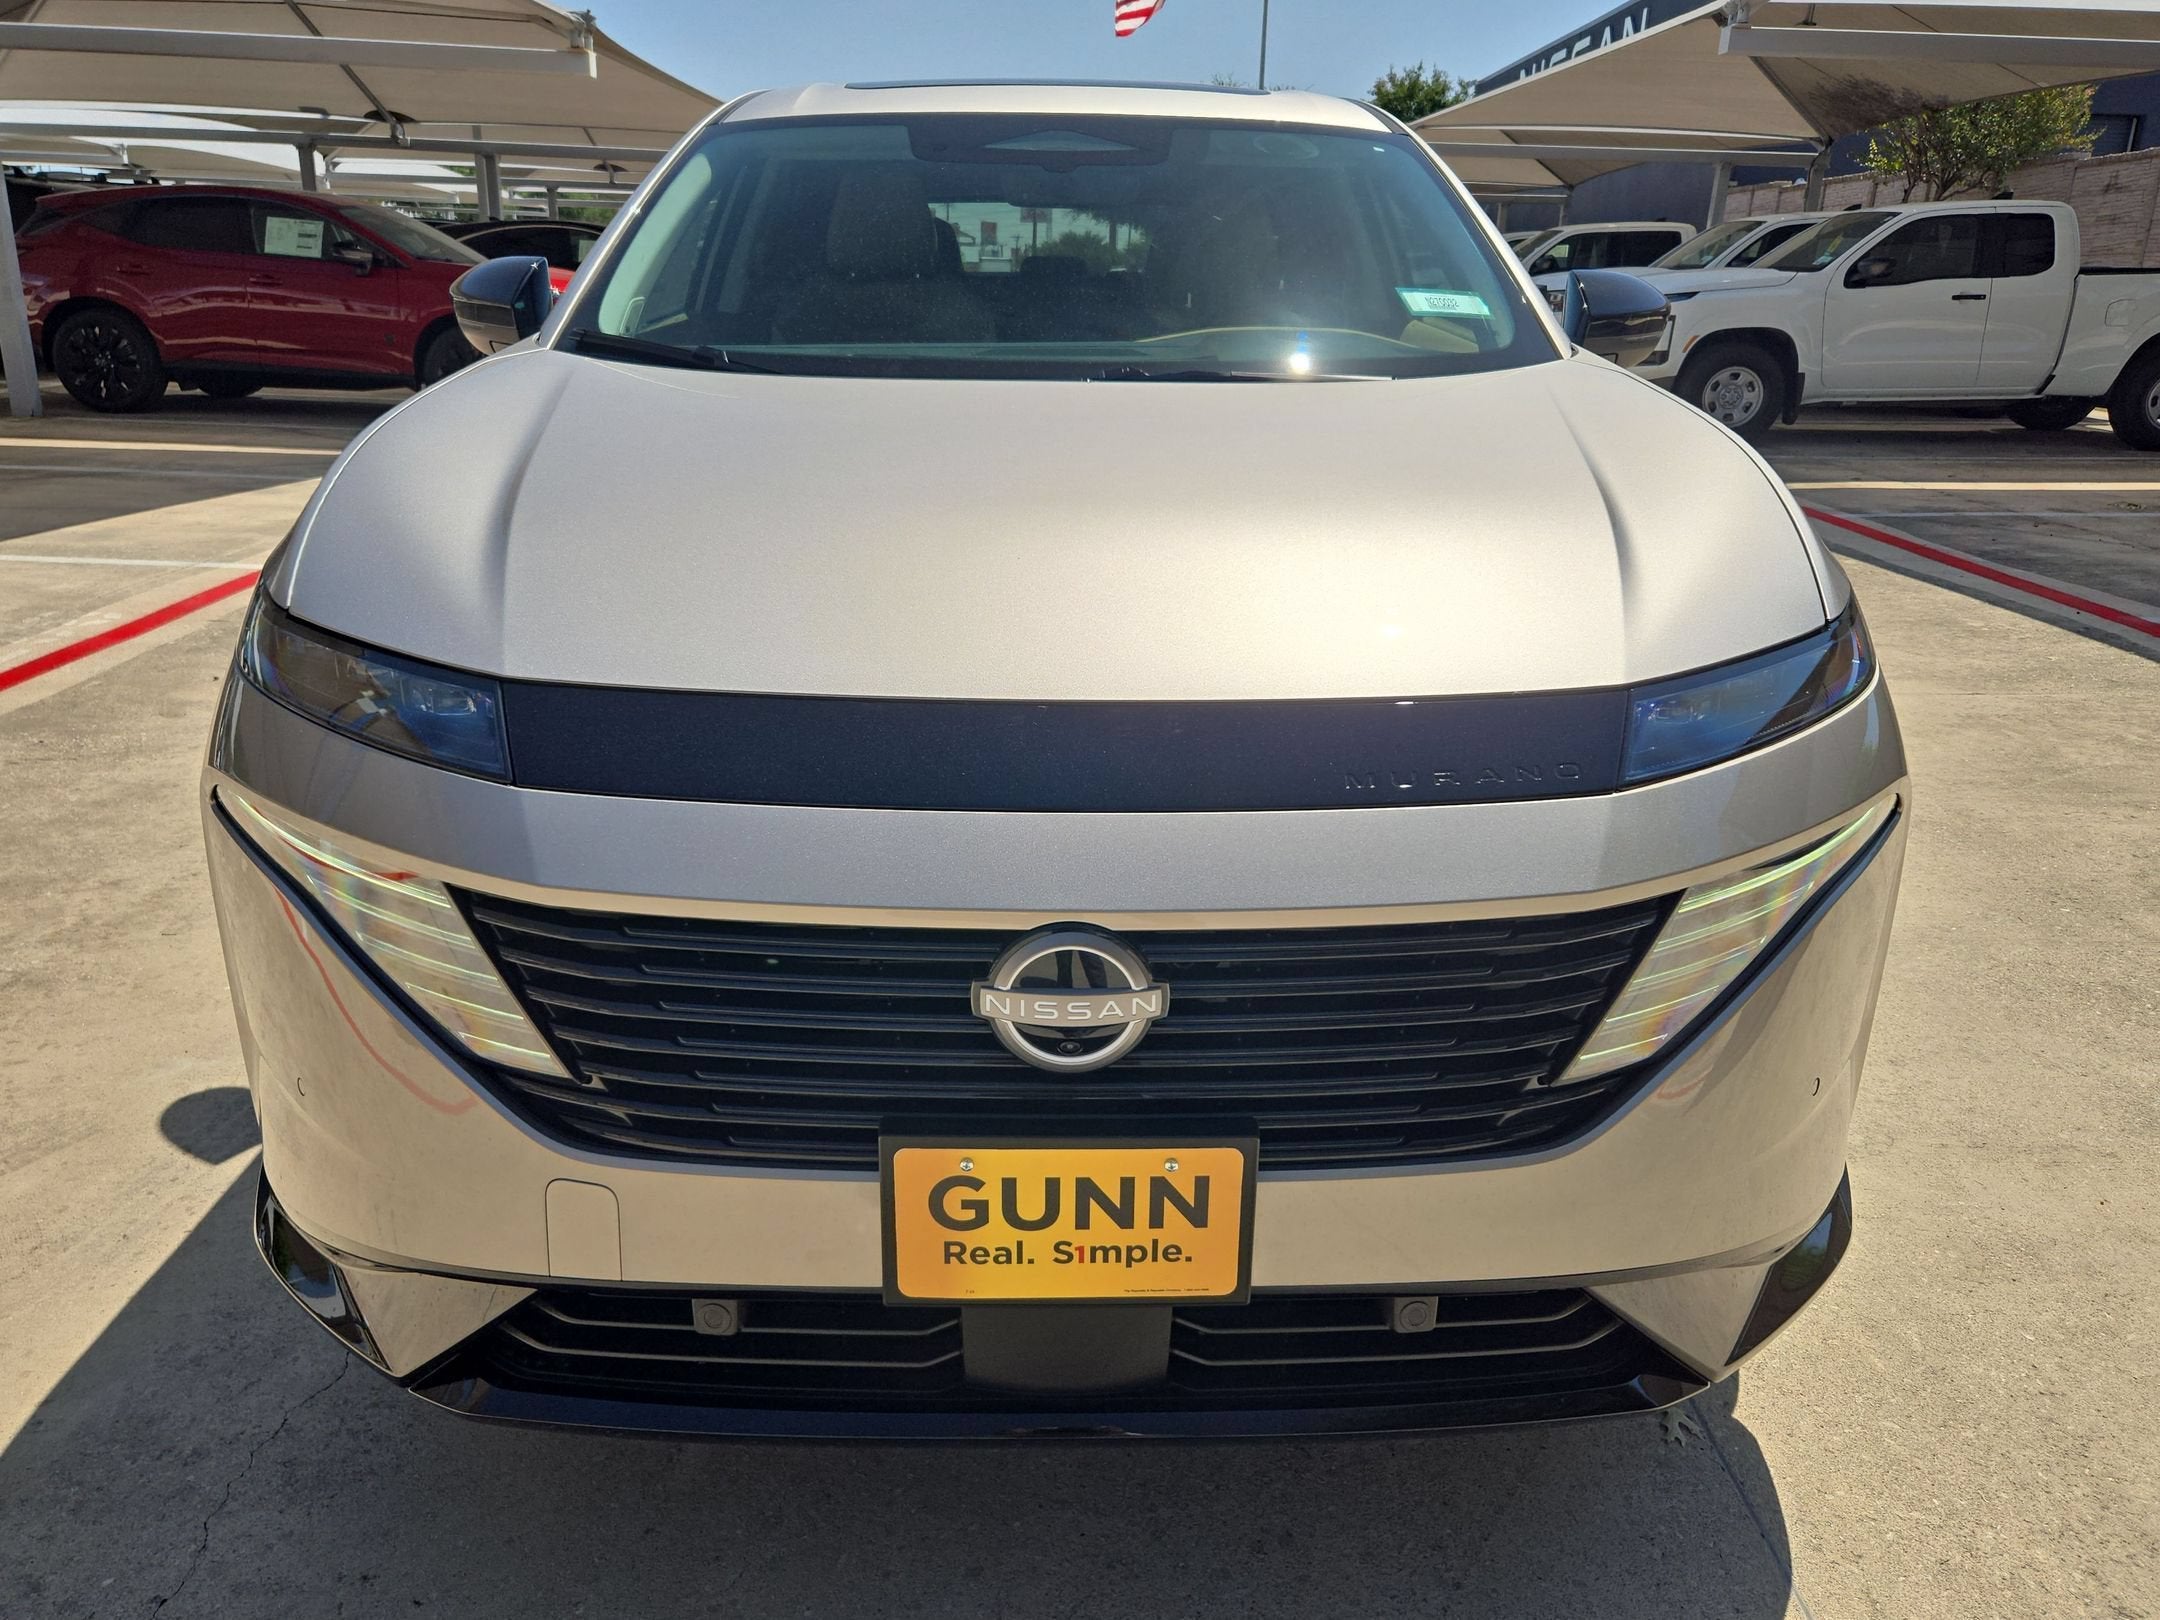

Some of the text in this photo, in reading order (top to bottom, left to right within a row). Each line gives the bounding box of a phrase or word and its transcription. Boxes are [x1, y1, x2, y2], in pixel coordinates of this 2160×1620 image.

[1344, 763, 1582, 790] MURANO
[985, 994, 1157, 1020] NISSAN
[928, 1174, 1210, 1232] GUNN
[943, 1239, 1035, 1265] Real.
